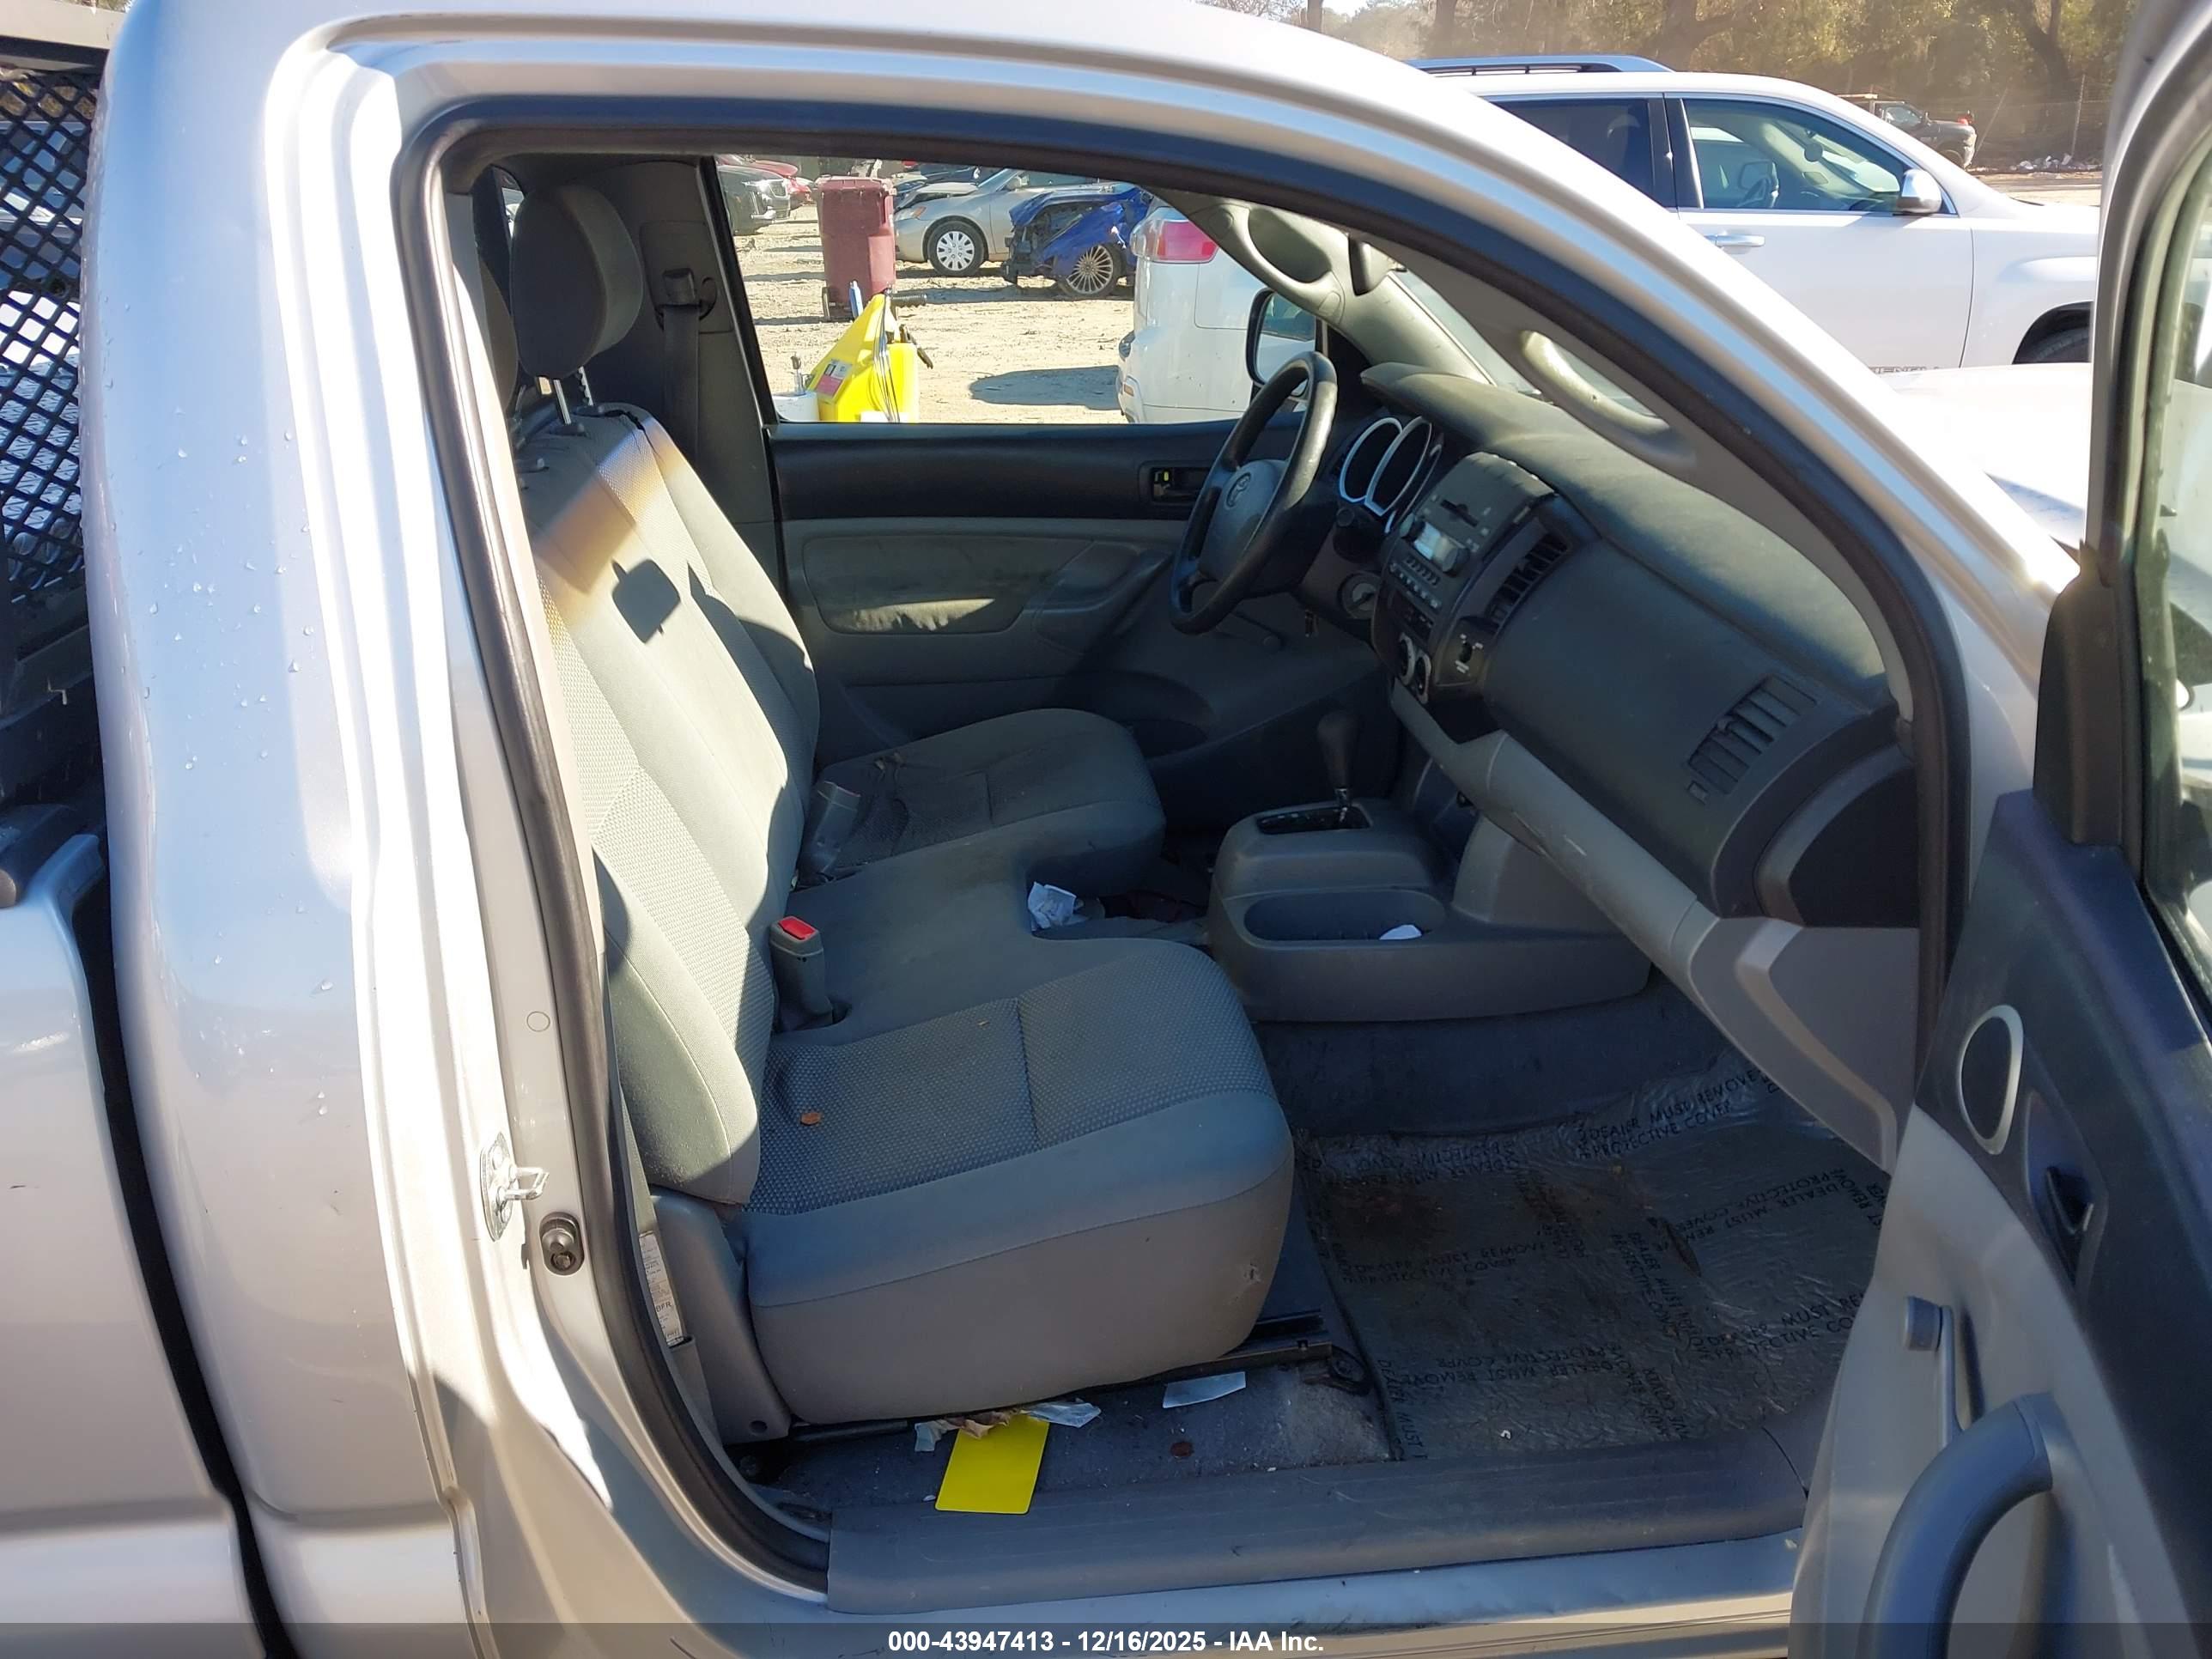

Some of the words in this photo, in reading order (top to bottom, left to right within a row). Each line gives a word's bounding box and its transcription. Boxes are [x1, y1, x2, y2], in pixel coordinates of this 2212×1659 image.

[1694, 1069, 1757, 1106] REMOVE
[1592, 1122, 1680, 1156] PROTECTIVE
[1682, 1099, 1734, 1130] COVER
